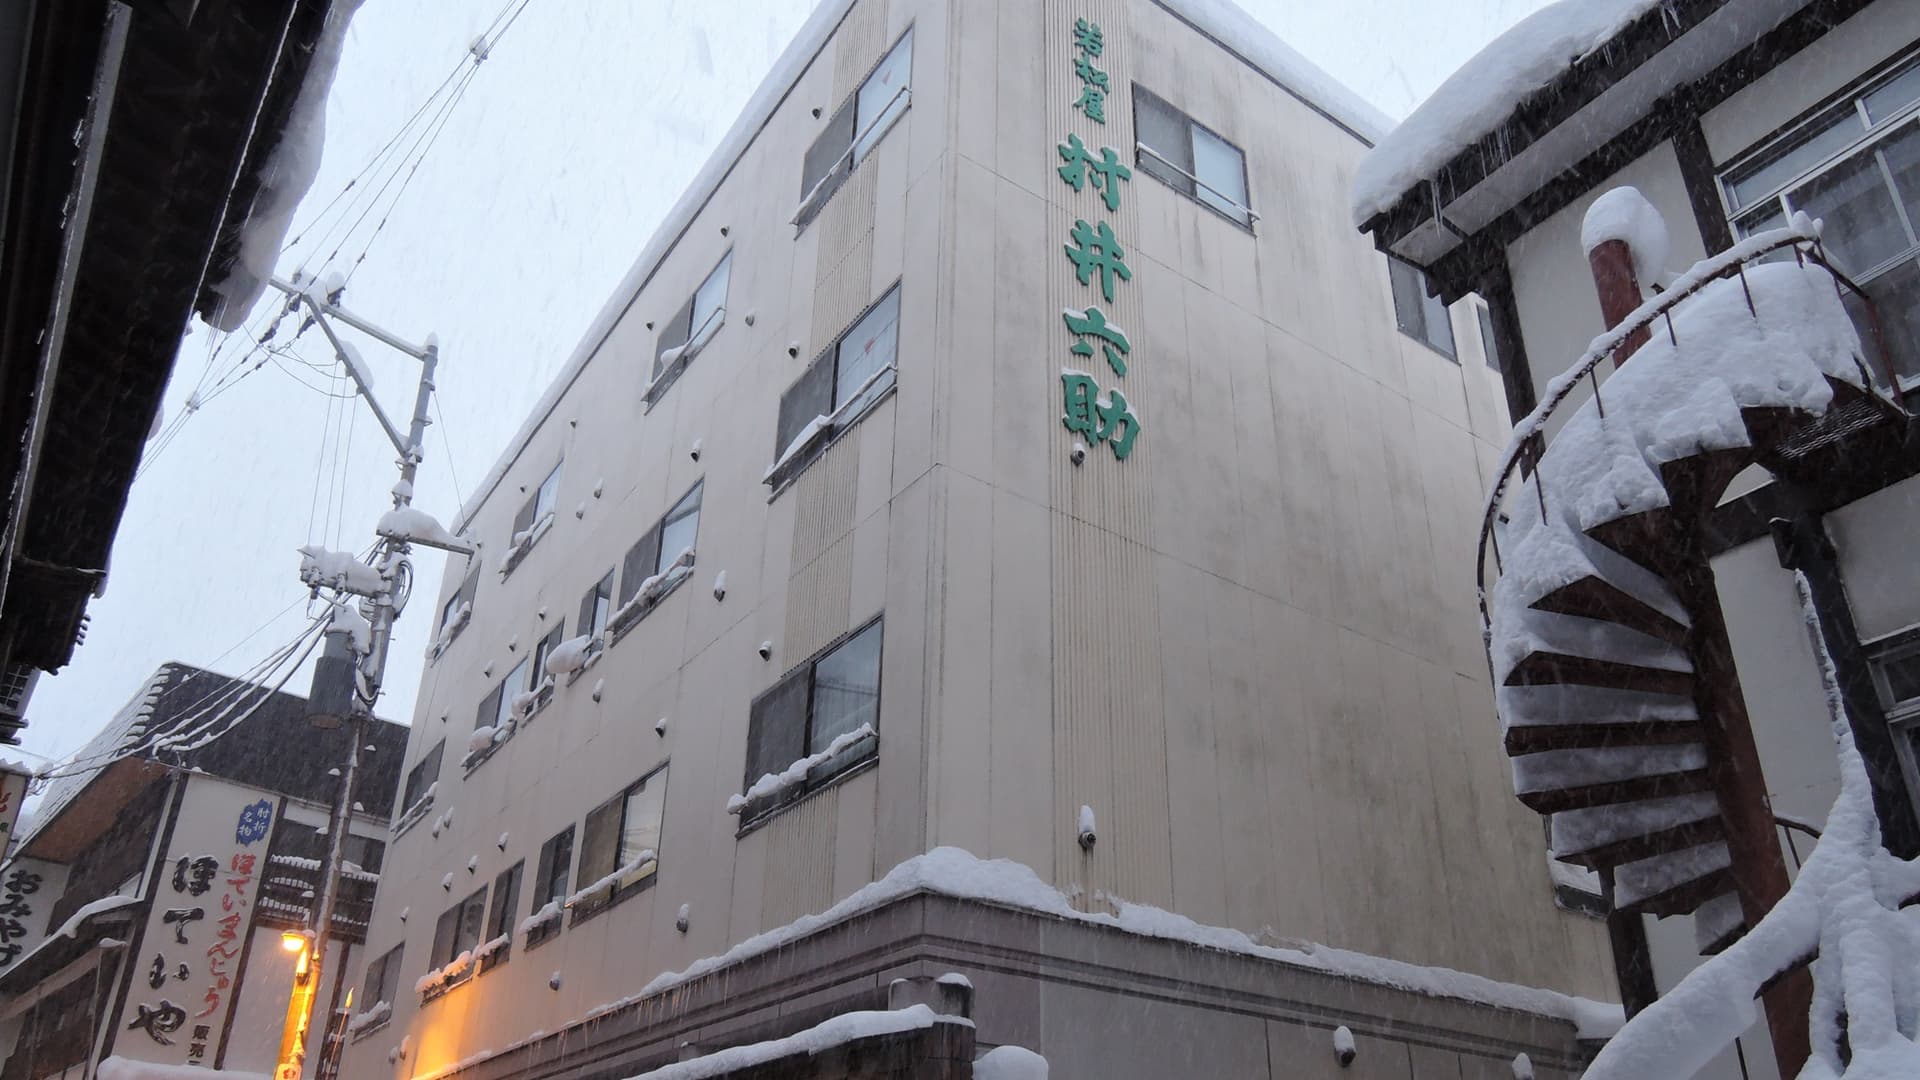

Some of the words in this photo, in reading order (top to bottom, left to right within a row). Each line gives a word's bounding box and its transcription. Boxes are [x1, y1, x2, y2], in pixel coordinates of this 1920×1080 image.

[1072, 16, 1110, 125] 若松屋
[1058, 132, 1141, 460] 村井六助
[128, 855, 219, 1046] ほていや
[195, 854, 257, 1019] ほていまんじゅう
[188, 1024, 210, 1064] 販売
